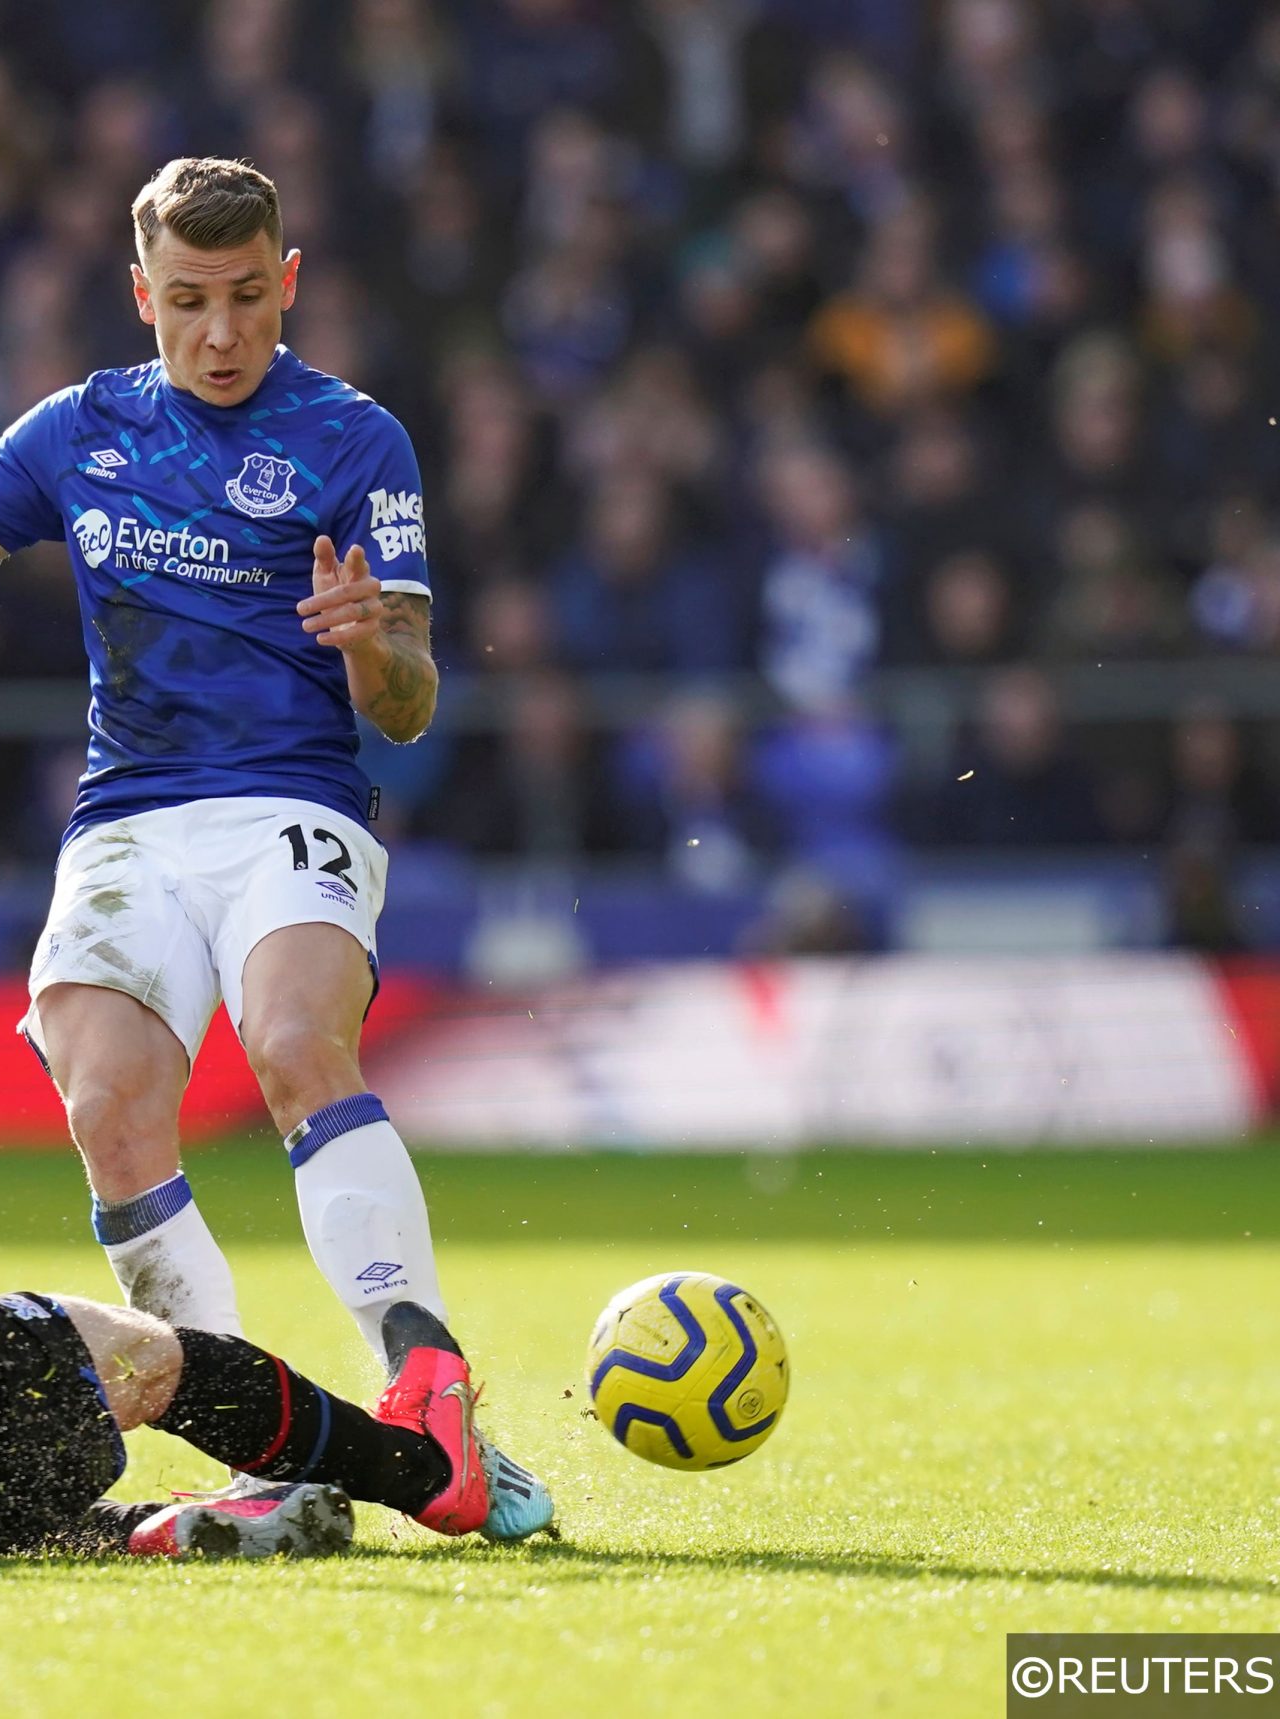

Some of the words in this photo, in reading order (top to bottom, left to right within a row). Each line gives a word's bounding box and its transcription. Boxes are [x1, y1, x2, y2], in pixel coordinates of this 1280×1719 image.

[85, 466, 117, 480] umbro
[242, 484, 279, 500] Everton
[367, 487, 425, 530] ANG
[115, 517, 230, 563] Everton
[370, 525, 427, 562] BIR
[115, 549, 129, 569] in
[131, 551, 159, 571] the
[163, 557, 276, 587] Community
[278, 823, 358, 895] 12
[320, 891, 355, 911] umbro
[363, 1277, 409, 1295] umbro
